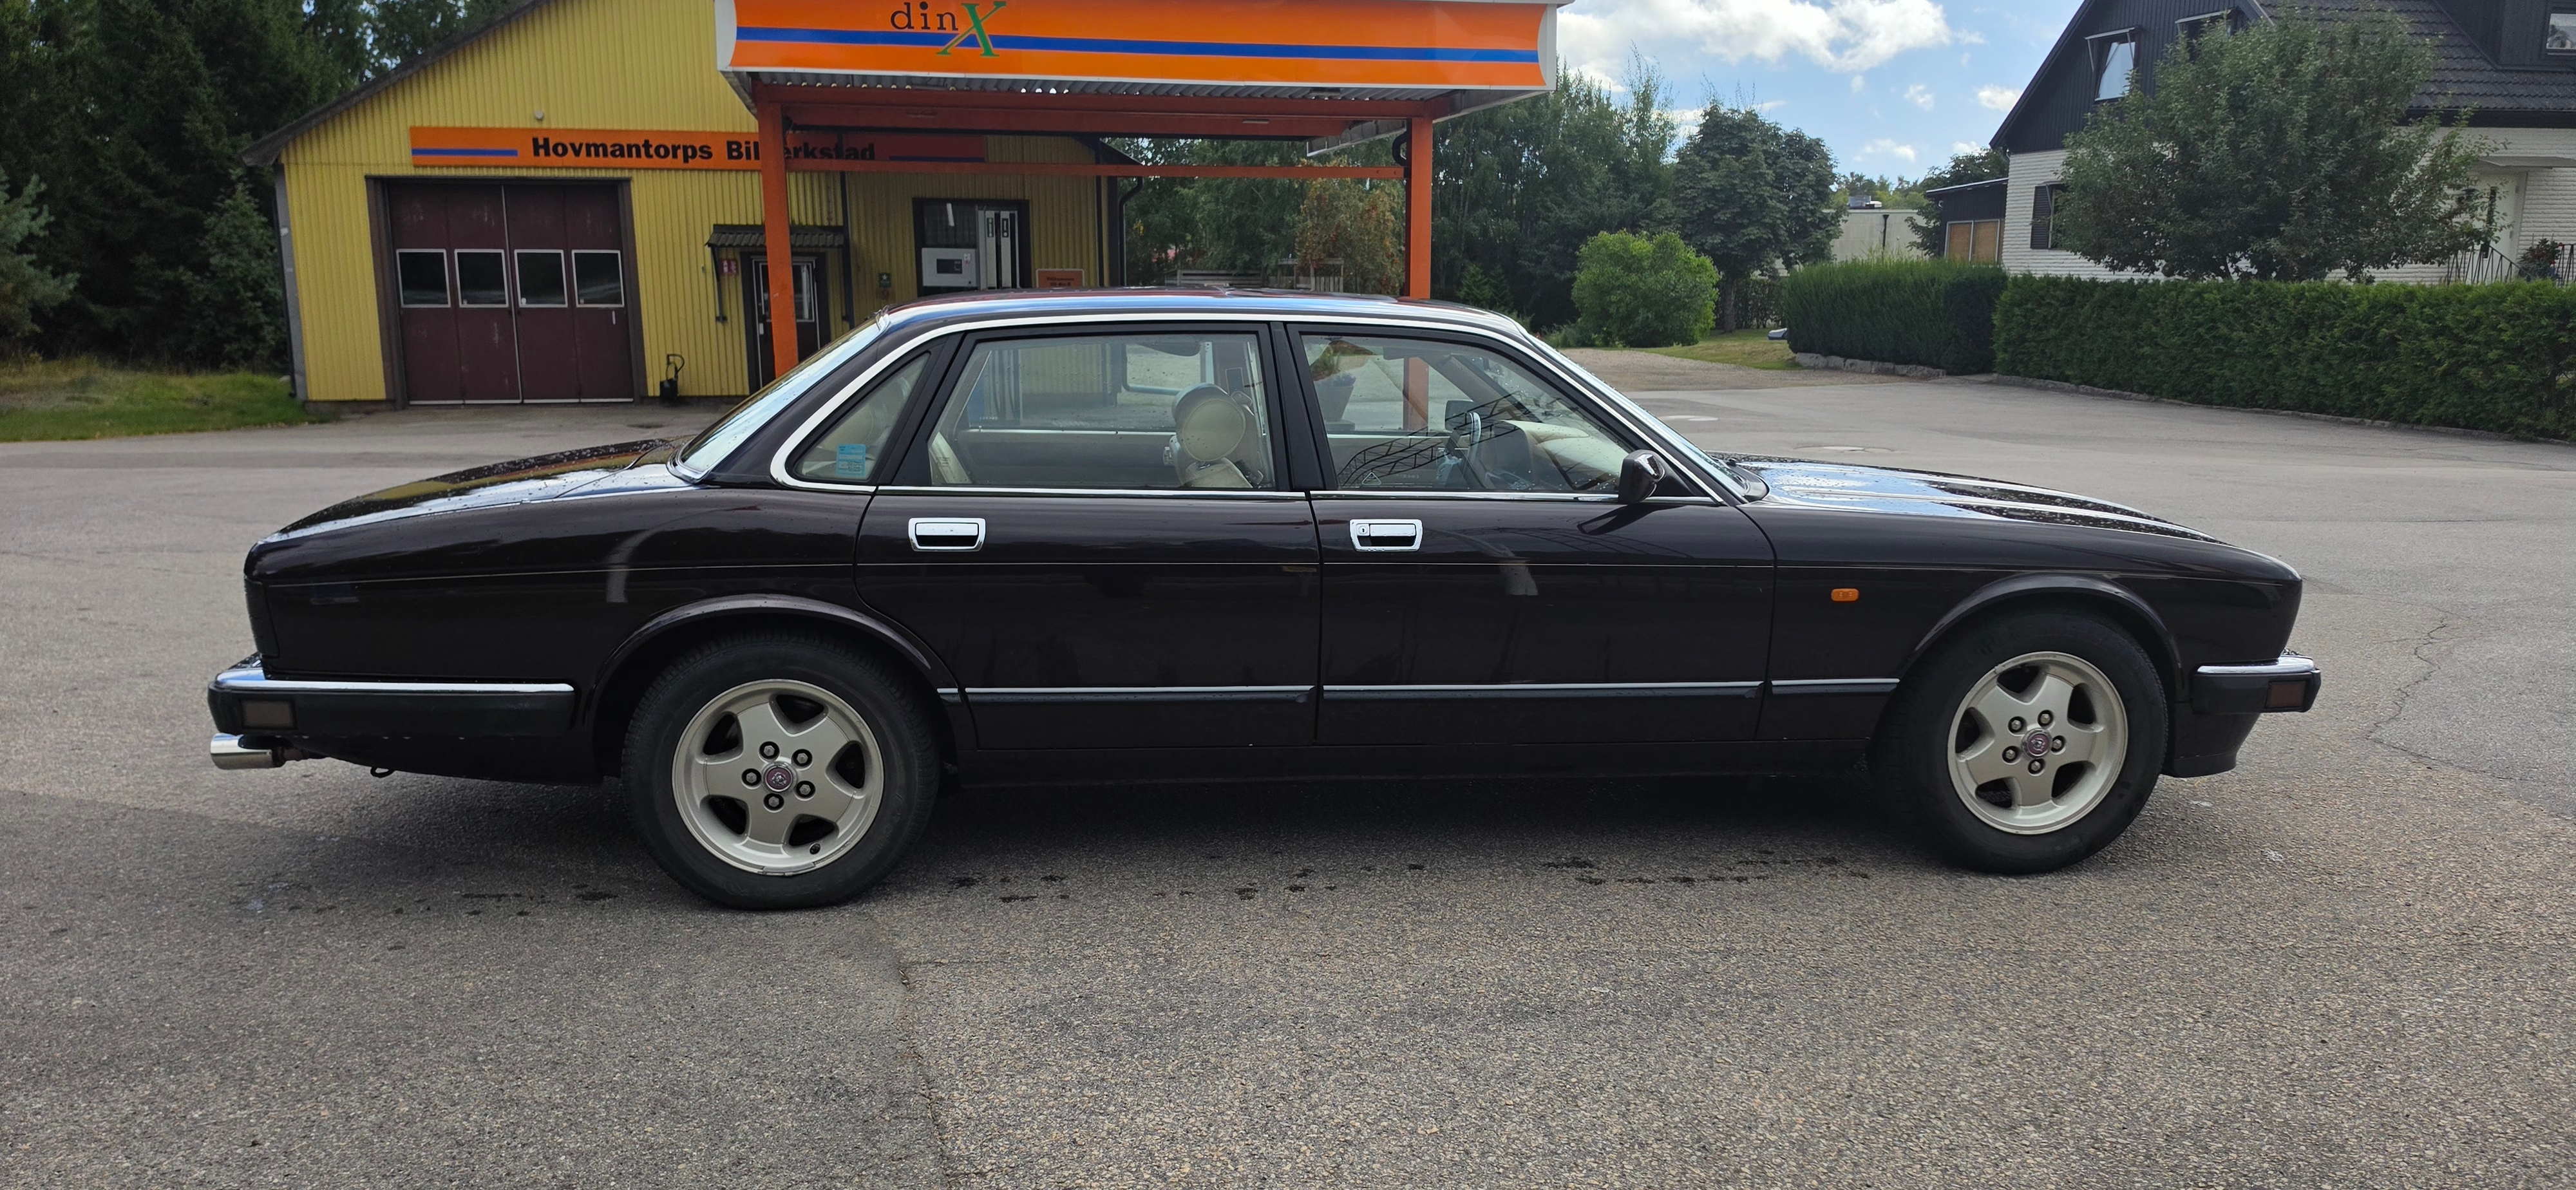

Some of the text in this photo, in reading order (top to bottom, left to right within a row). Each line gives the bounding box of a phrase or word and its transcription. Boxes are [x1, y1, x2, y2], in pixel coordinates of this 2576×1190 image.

[891, 1, 1007, 57] dinX
[532, 137, 875, 164] Hovmantorps Bilerkstad
